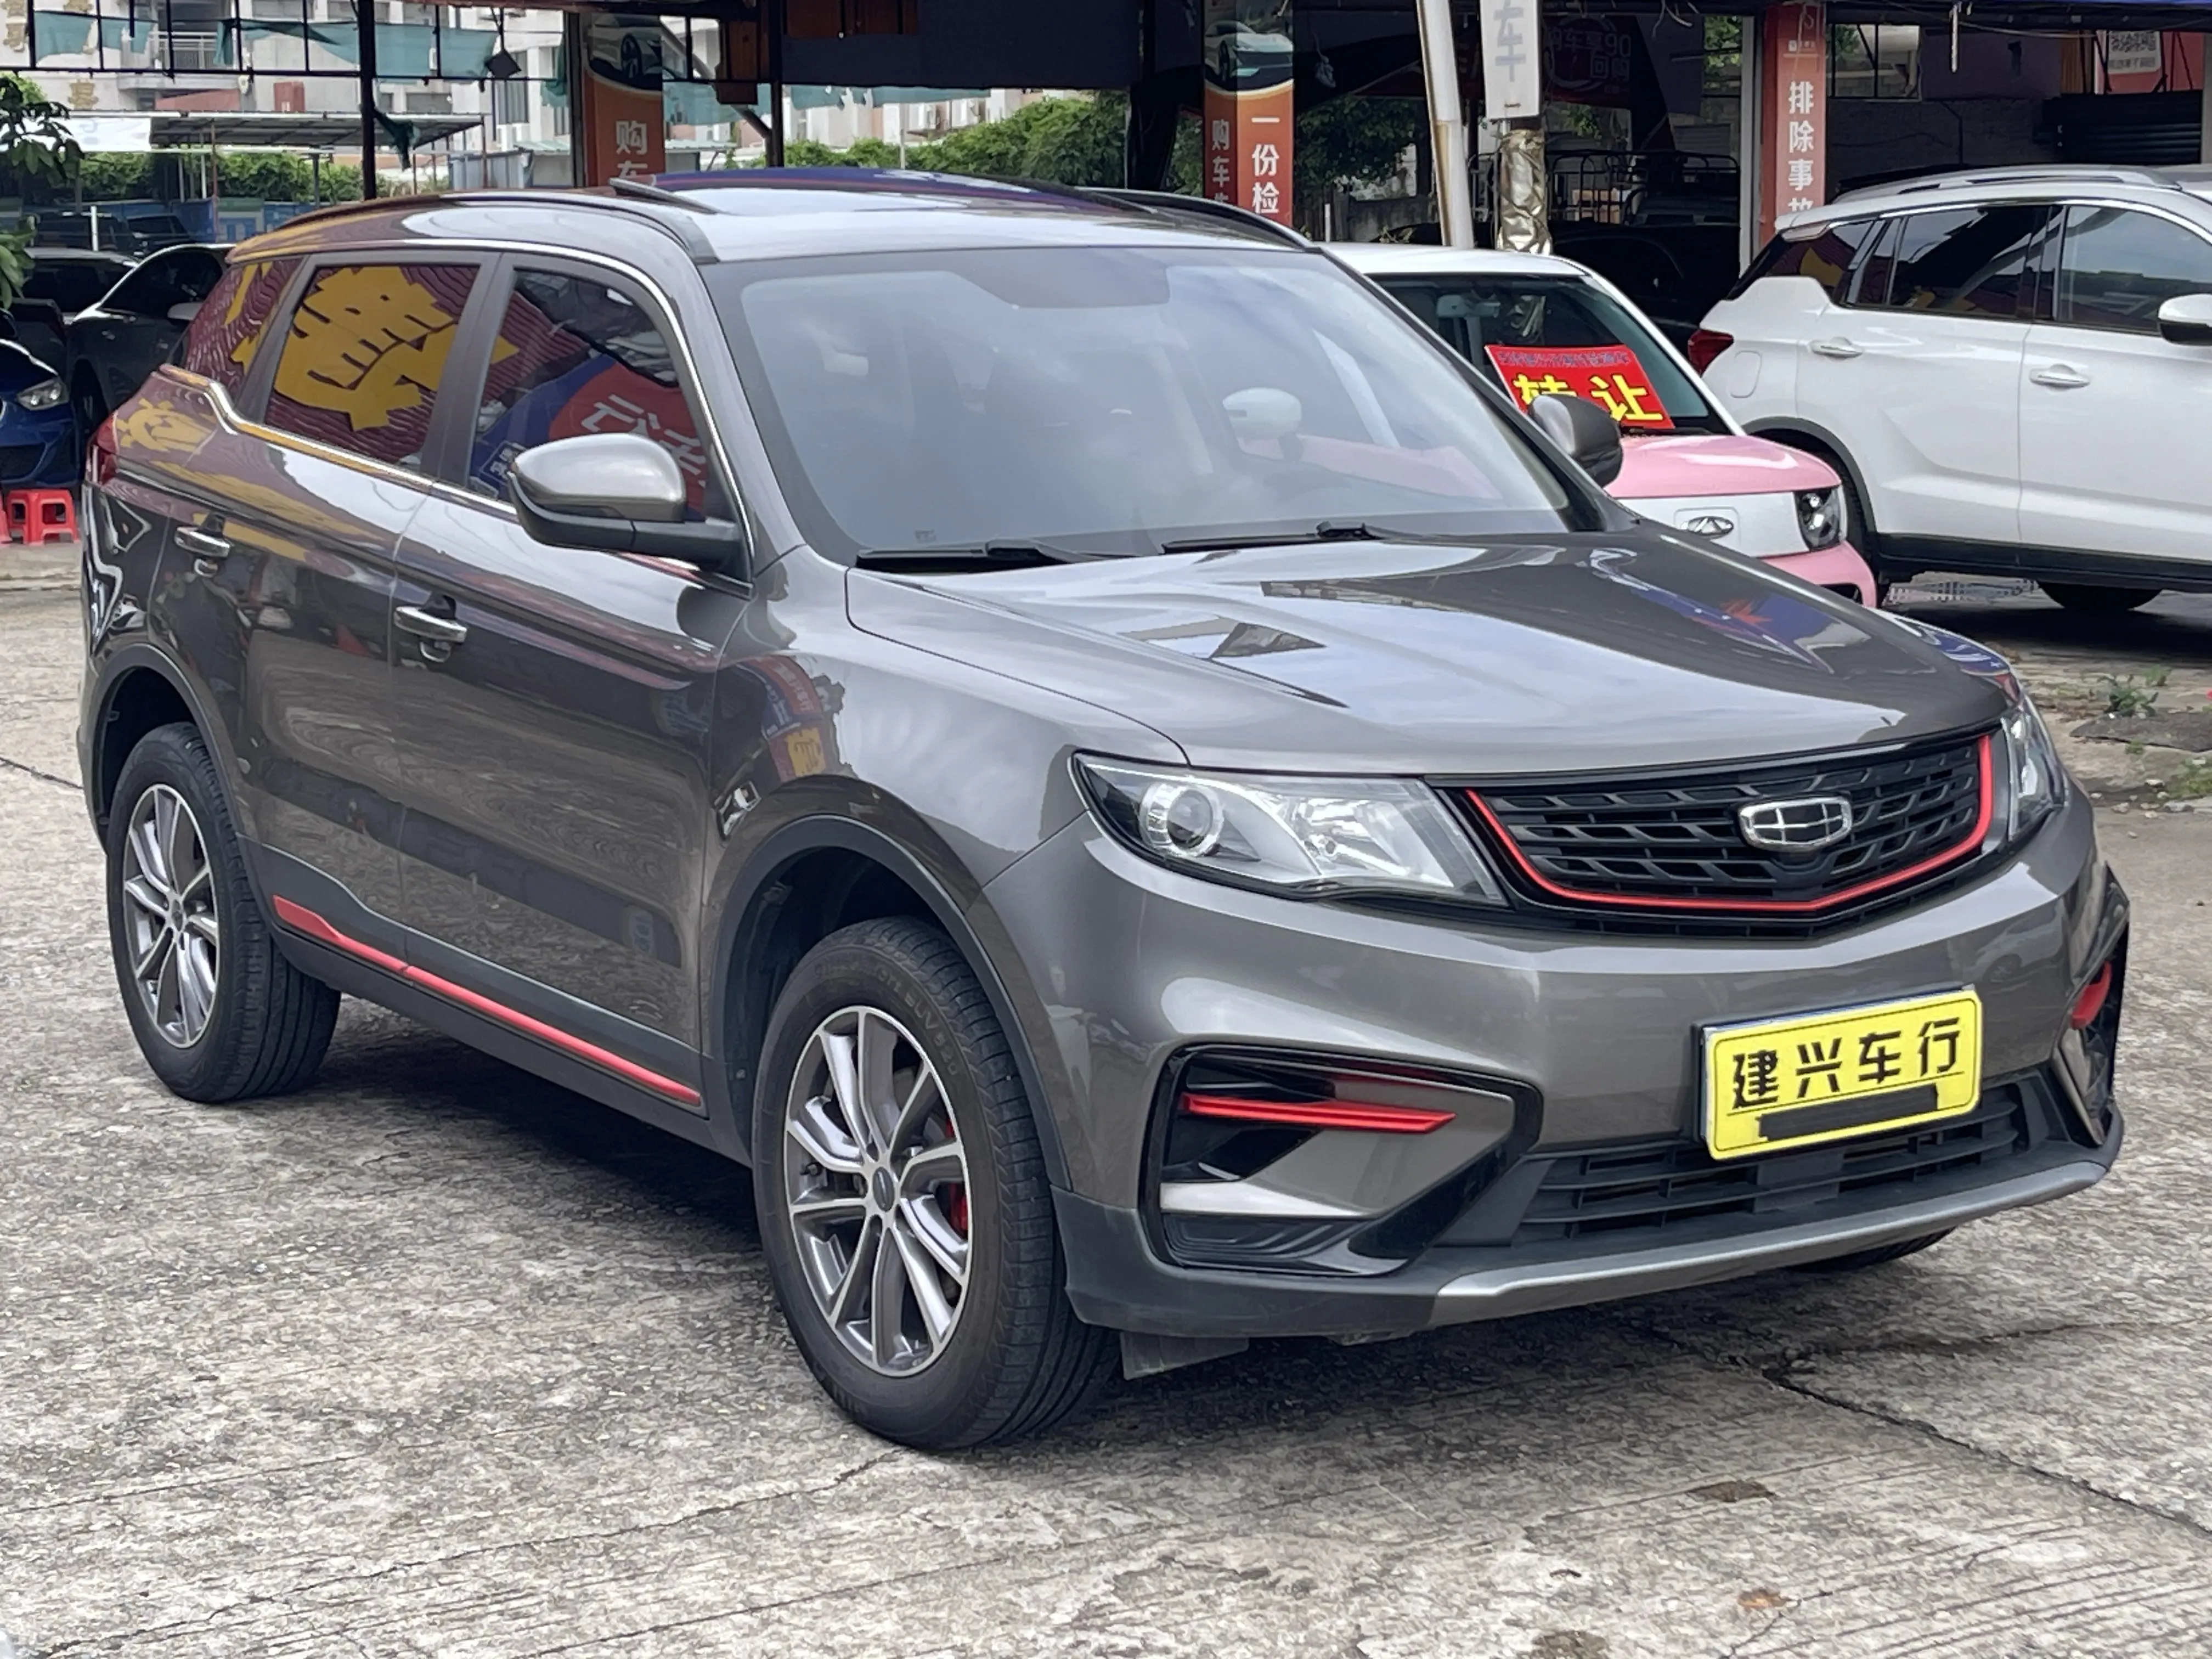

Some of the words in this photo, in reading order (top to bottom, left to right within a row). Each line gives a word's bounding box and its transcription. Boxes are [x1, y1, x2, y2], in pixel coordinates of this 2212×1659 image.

[1493, 0, 1527, 82] 车
[1250, 117, 1280, 215] 一份检
[1732, 1016, 1960, 1109] 建兴车行
